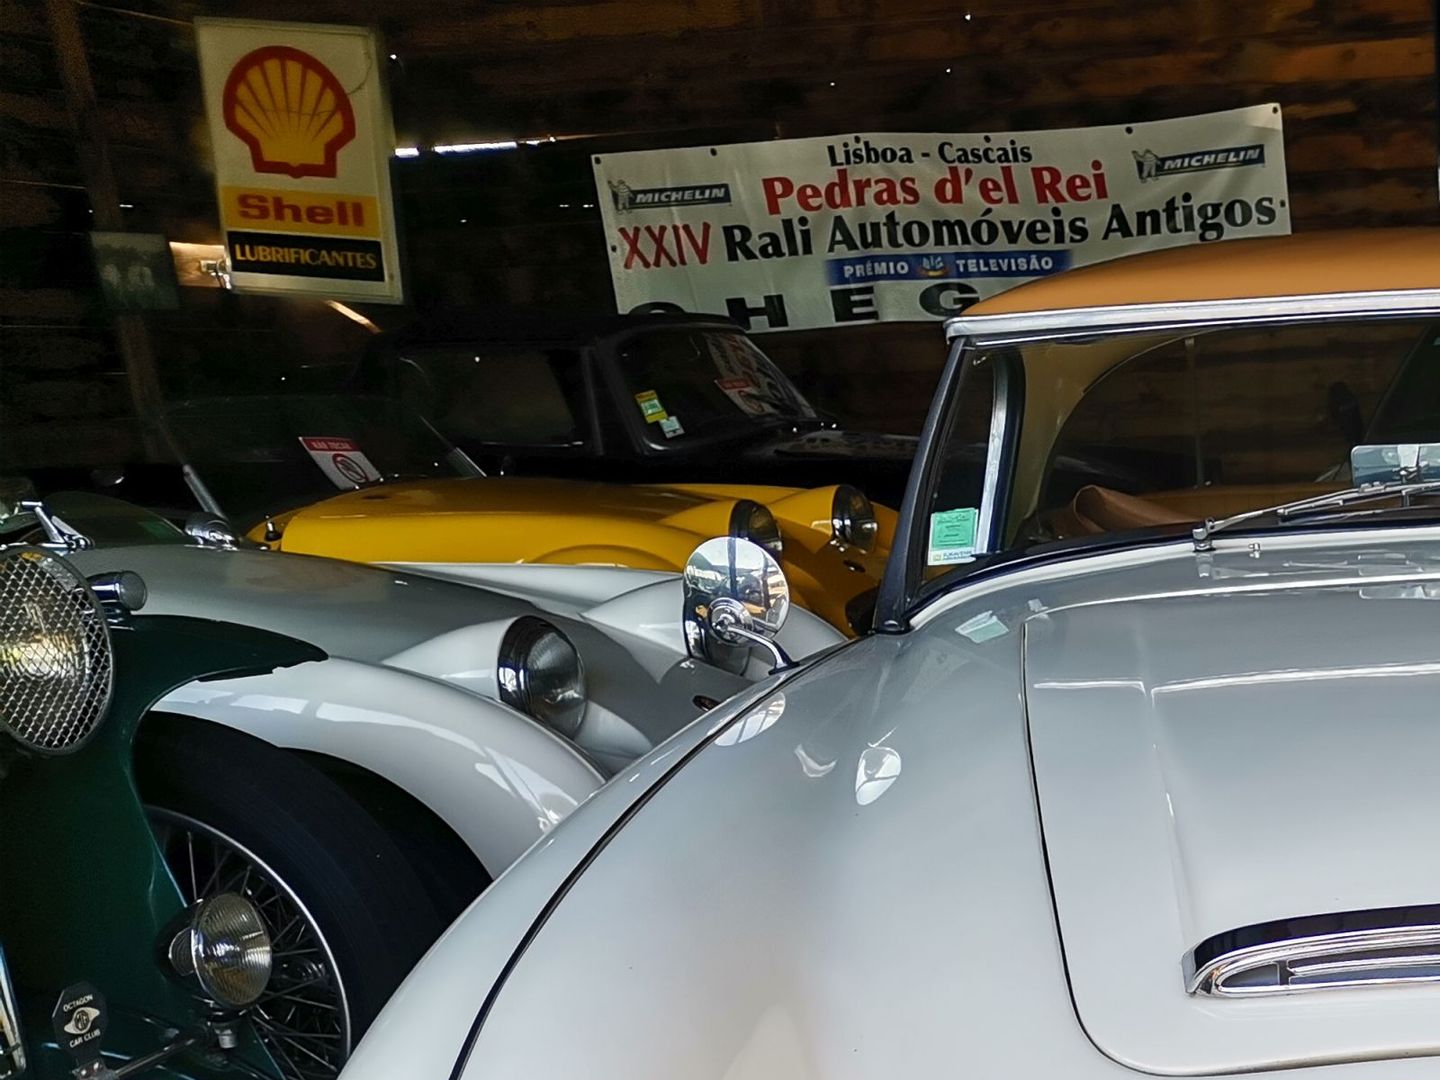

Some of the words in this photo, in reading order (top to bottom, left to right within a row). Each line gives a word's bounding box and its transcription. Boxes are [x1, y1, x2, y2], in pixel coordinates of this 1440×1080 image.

[826, 141, 914, 167] Lisboa
[938, 139, 1033, 165] Cascais
[1163, 147, 1261, 170] MICHELIN
[635, 187, 726, 204] MICHELIN
[761, 168, 920, 215] Pedras
[934, 166, 1020, 205] d'el
[1031, 159, 1109, 205] Rei
[236, 192, 365, 227] Shell
[618, 221, 711, 270] XXIV
[722, 215, 813, 262] Rali
[827, 206, 1089, 254] Automóveis
[1101, 191, 1277, 242] Antigos
[234, 243, 378, 270] LUBRIFICANTES
[842, 261, 910, 279] PRÉMIO
[955, 256, 1054, 274] TELEVISÃO
[63, 994, 94, 1013] OCTAGON
[69, 1036, 83, 1049] CAR
[83, 1028, 101, 1042] CLUB
